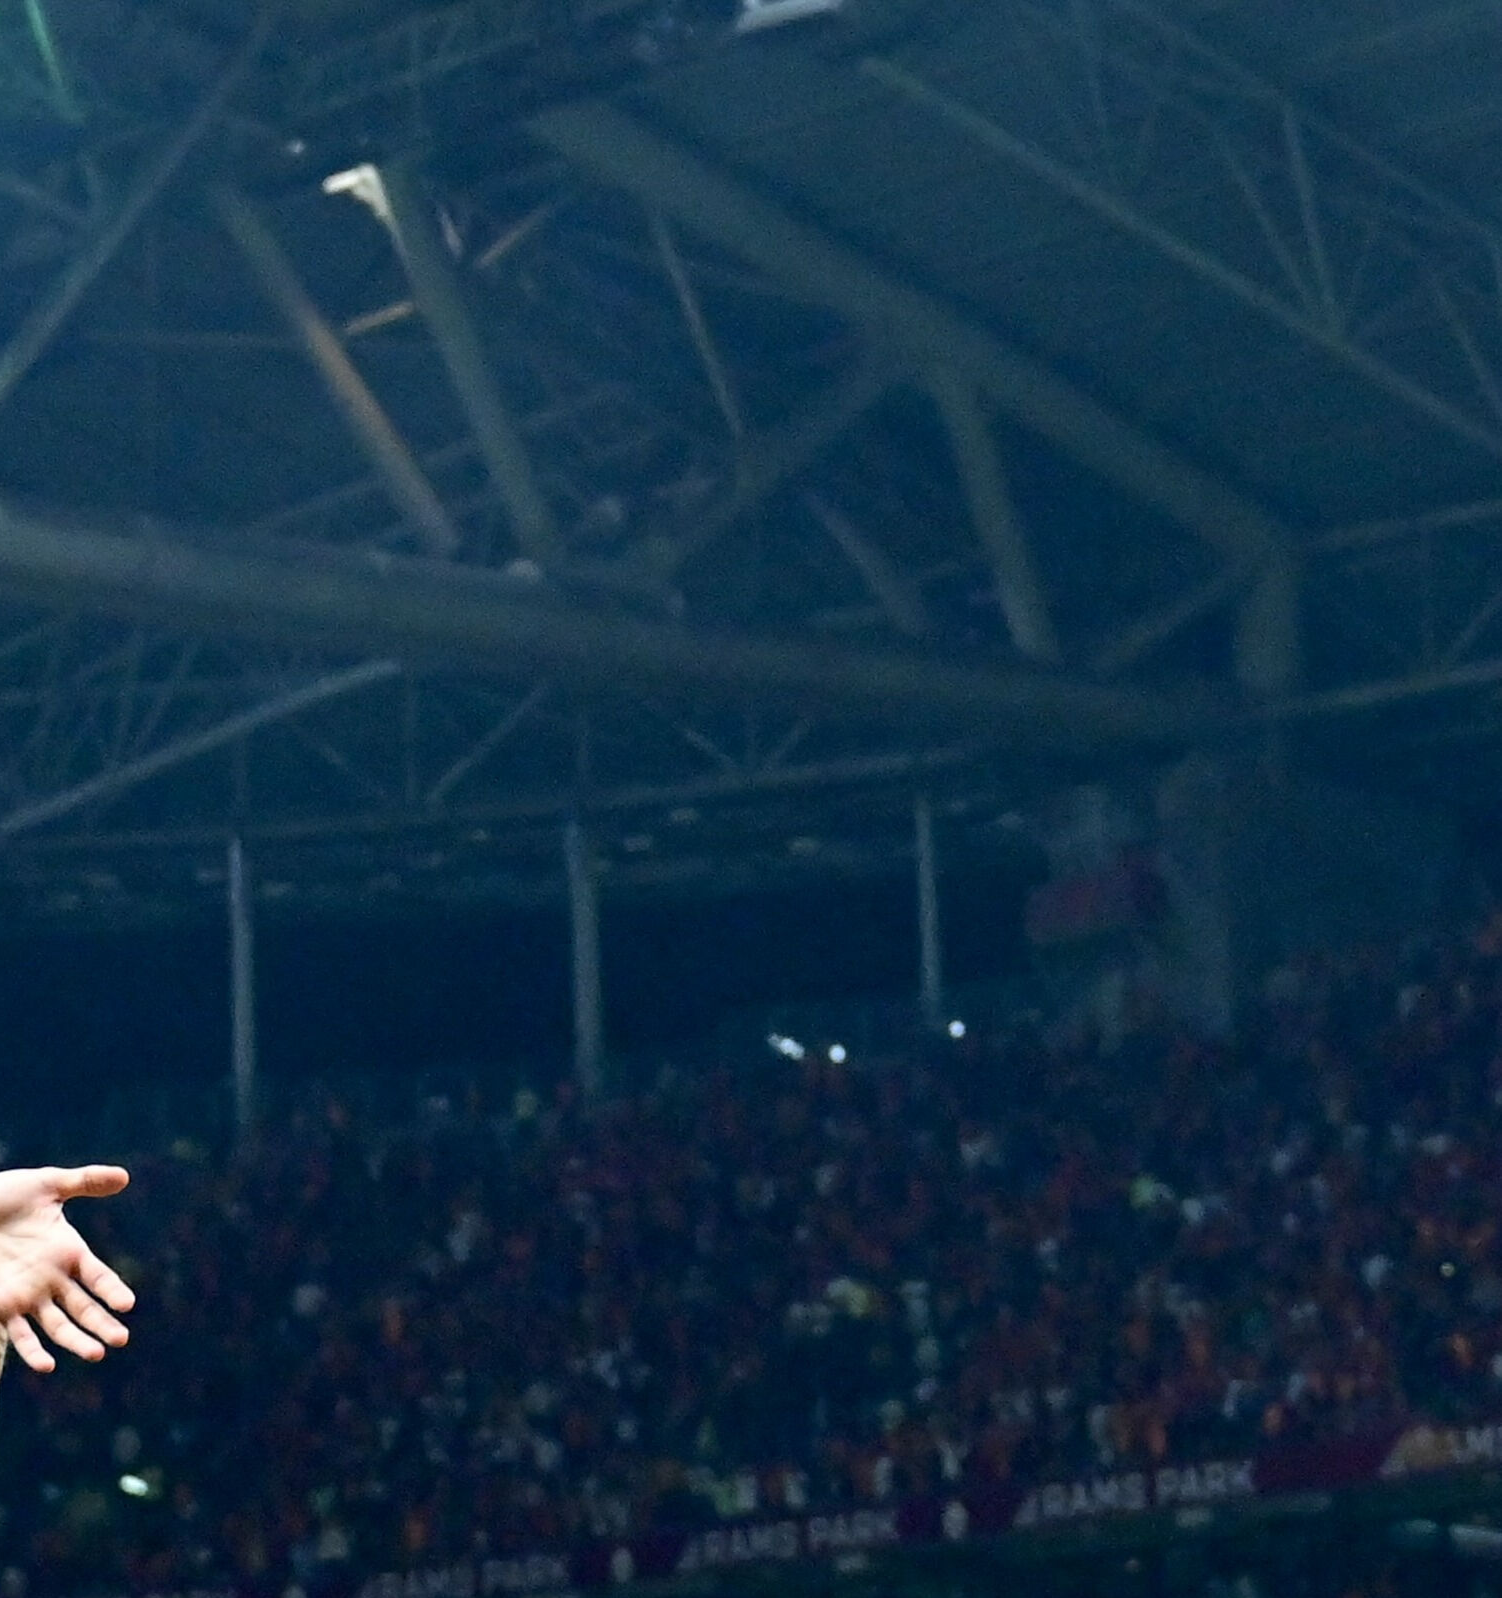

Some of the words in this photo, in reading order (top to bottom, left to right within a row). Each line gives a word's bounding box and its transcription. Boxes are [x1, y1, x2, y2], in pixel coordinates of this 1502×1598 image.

[1041, 1471, 1146, 1517] RAMS
[1154, 1461, 1254, 1504] PARK
[704, 1520, 797, 1562] RAMS
[808, 1510, 898, 1550] PARK
[481, 1554, 570, 1596] PARK
